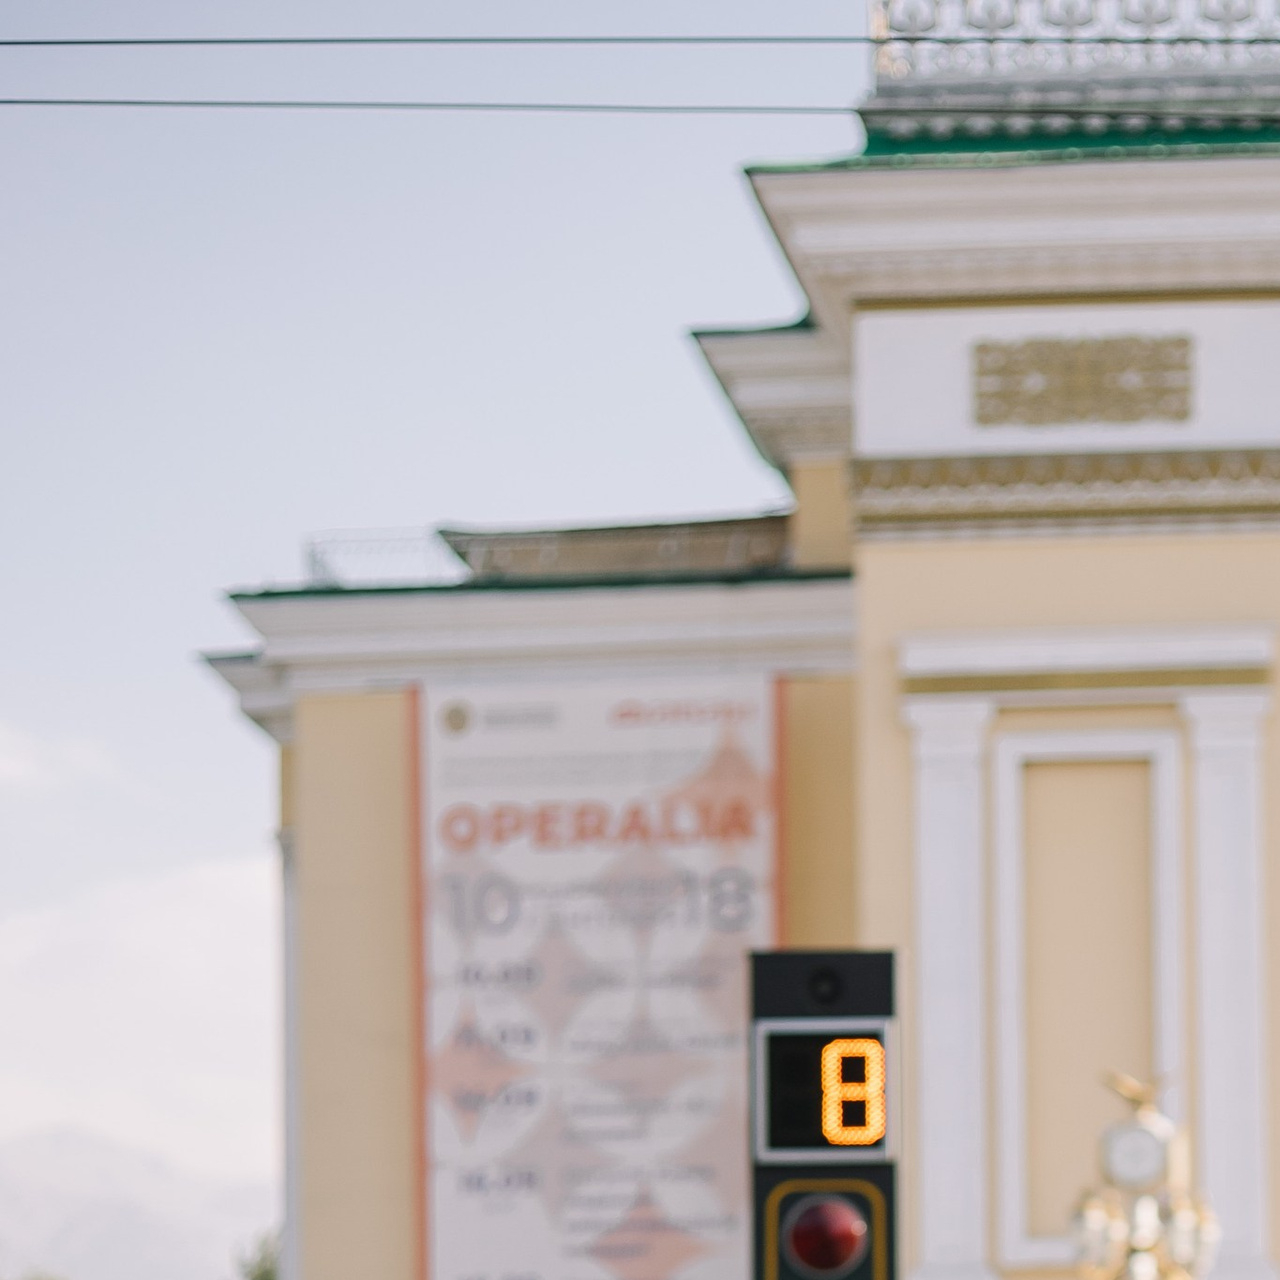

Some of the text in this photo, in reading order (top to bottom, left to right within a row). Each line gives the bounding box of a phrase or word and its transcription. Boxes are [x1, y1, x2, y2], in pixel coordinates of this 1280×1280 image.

[440, 804, 755, 848] OPERALIA
[442, 873, 518, 933] 10
[822, 1039, 886, 1145] 8
